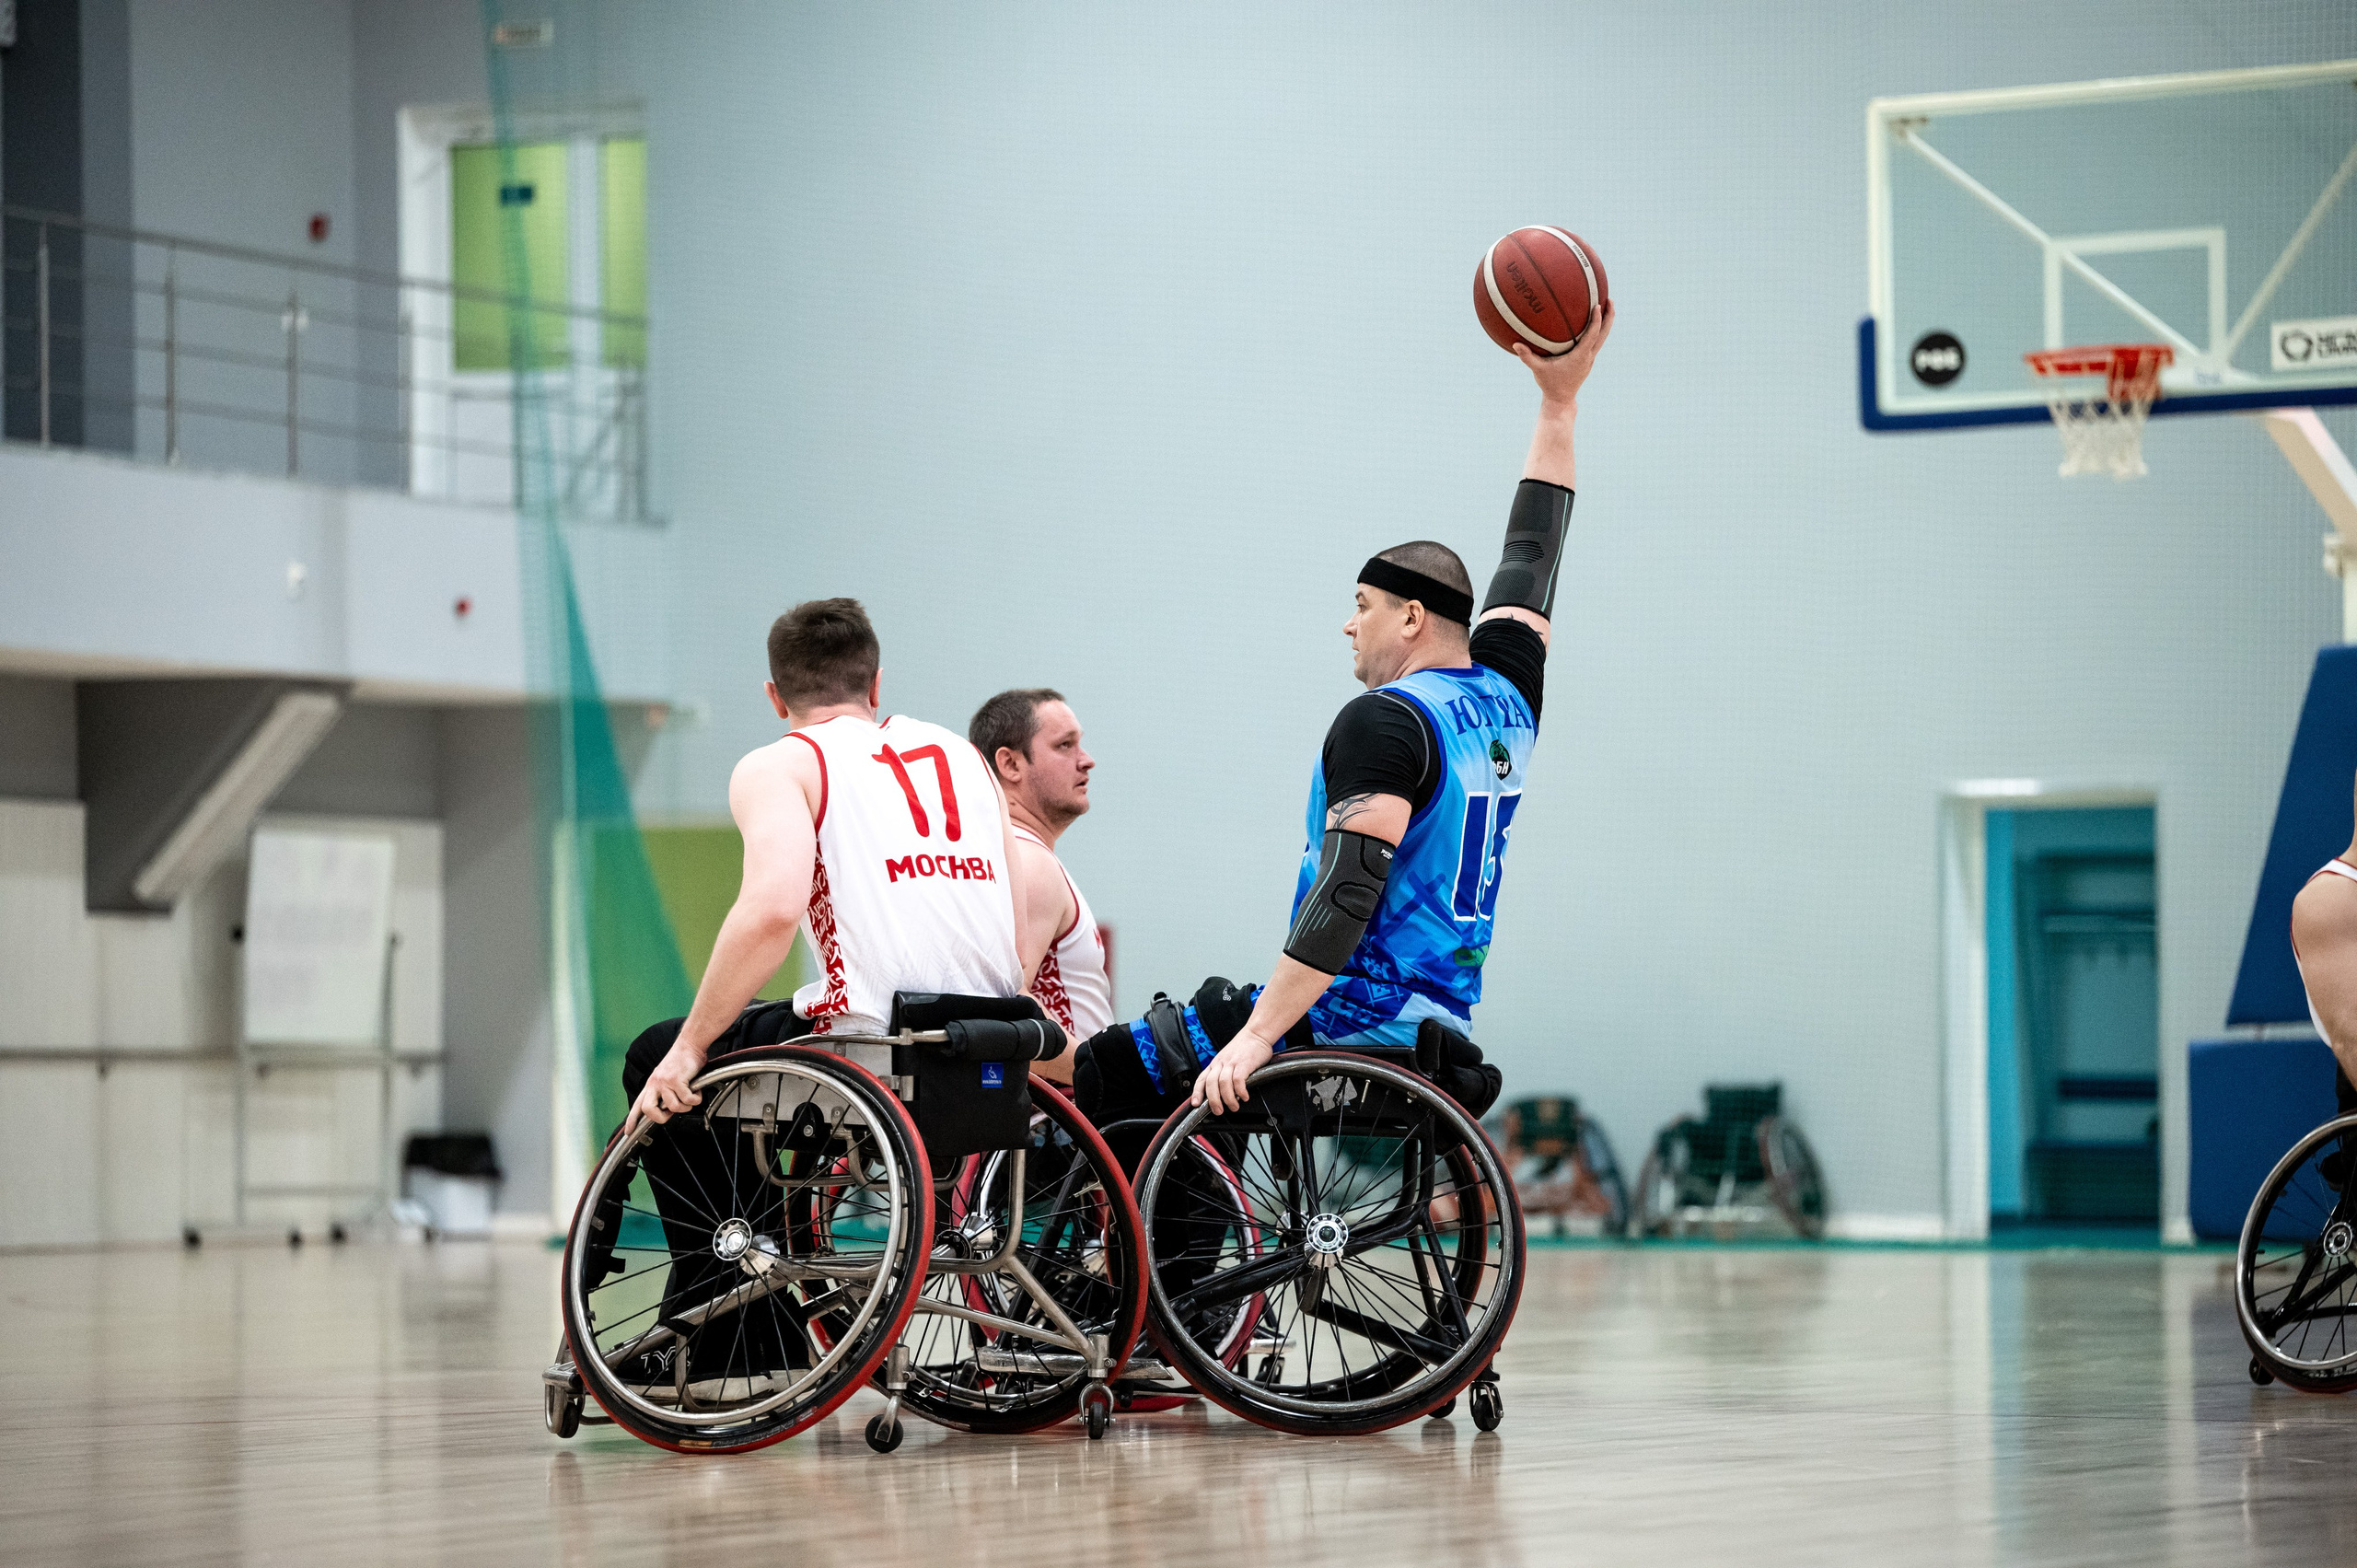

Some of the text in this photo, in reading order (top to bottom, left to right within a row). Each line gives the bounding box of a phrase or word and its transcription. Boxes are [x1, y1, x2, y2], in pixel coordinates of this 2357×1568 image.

[1506, 261, 1546, 314] molten
[872, 743, 961, 842] 17
[1452, 788, 1522, 921] 15
[641, 1345, 691, 1375] TY
